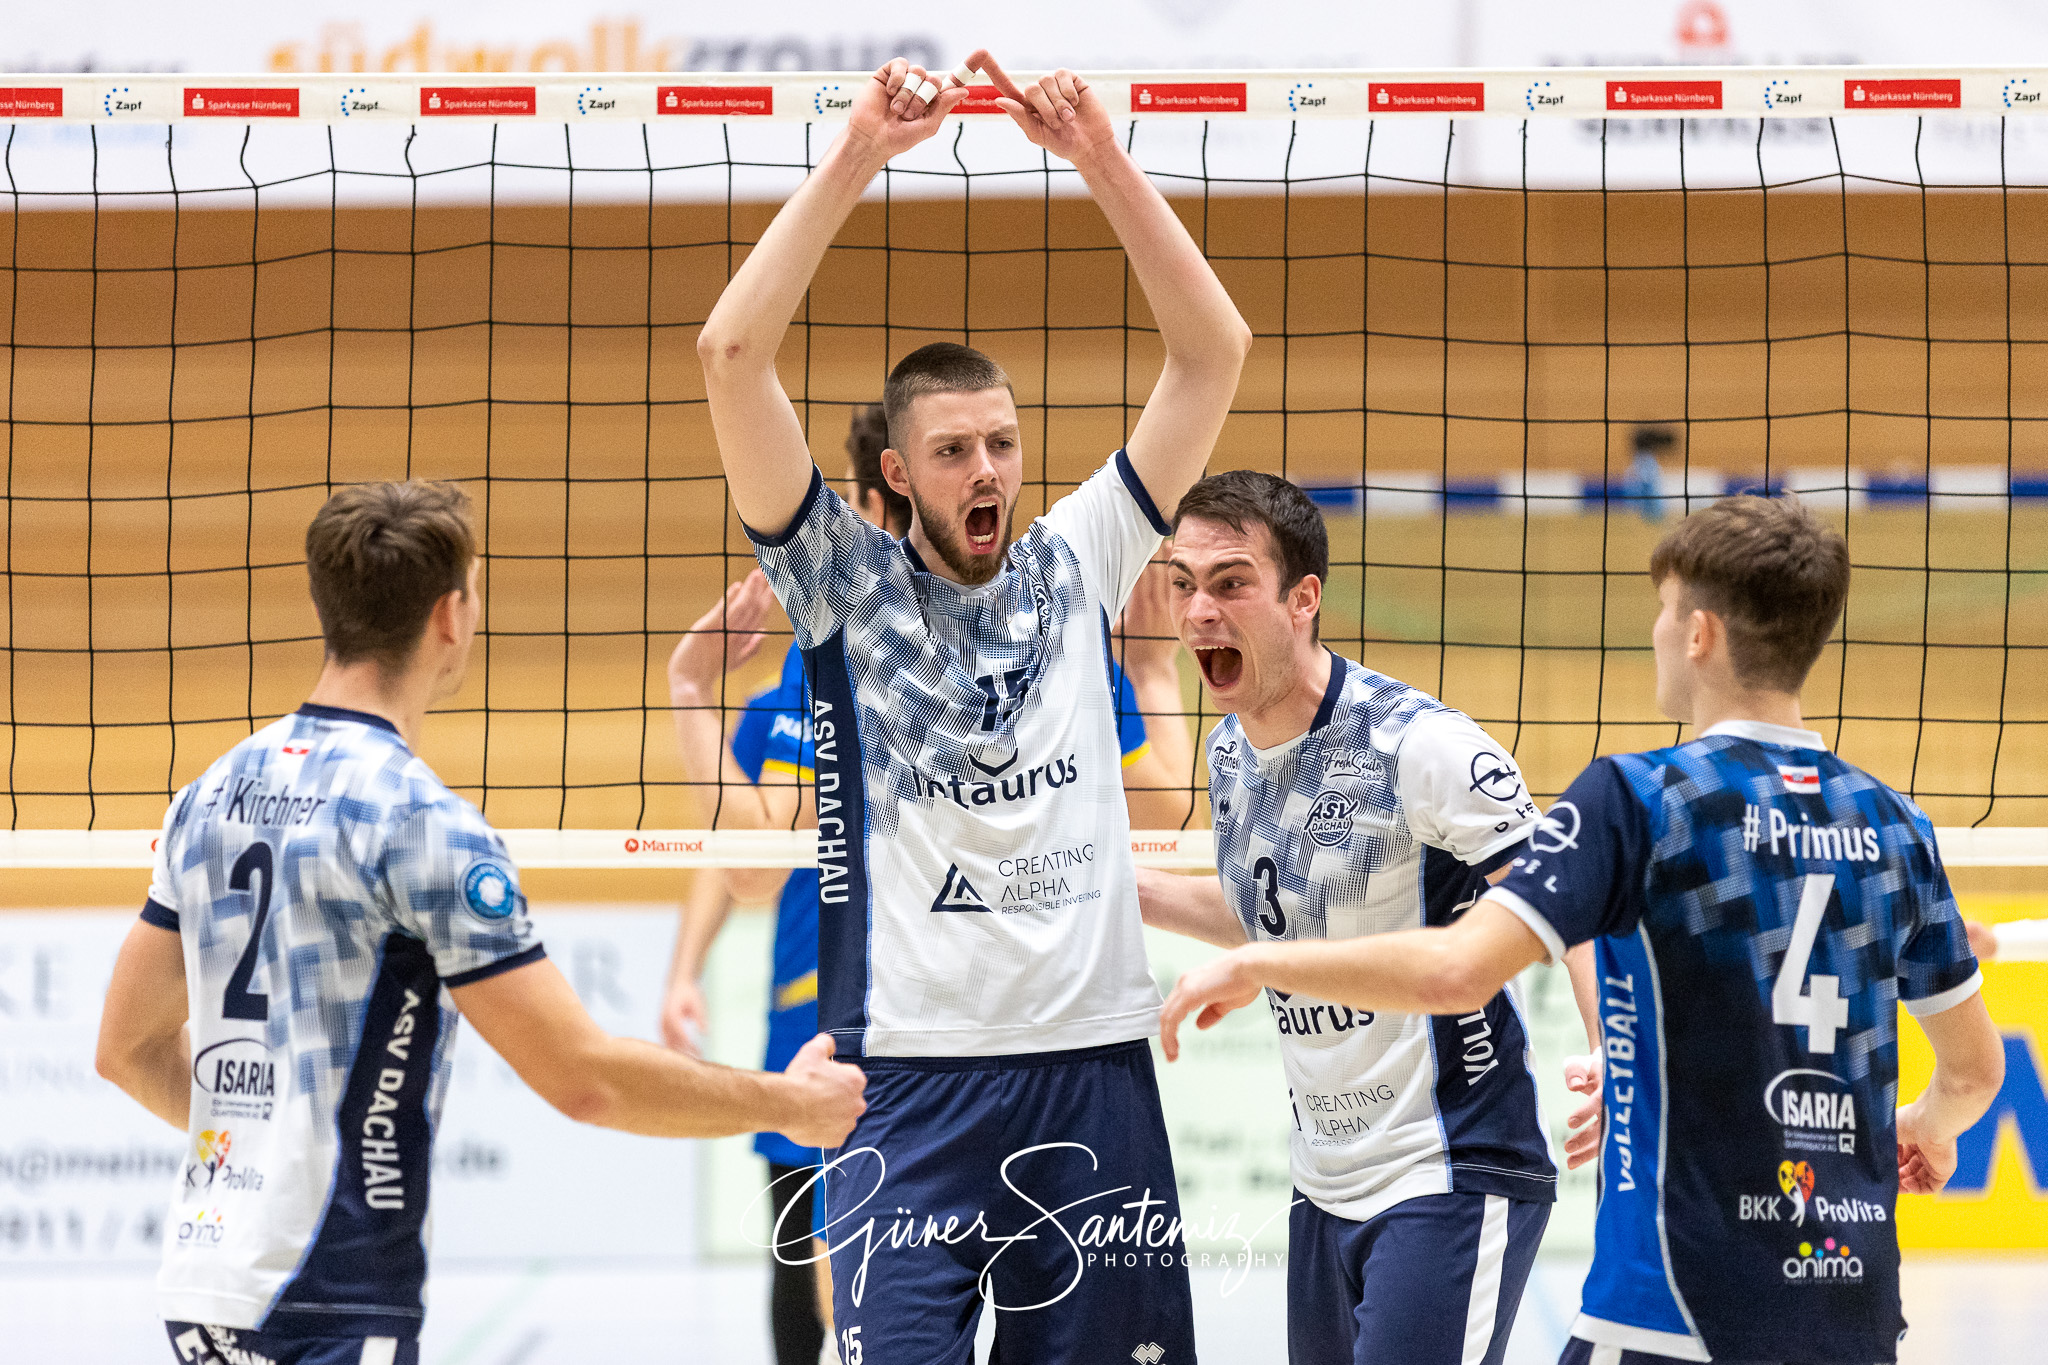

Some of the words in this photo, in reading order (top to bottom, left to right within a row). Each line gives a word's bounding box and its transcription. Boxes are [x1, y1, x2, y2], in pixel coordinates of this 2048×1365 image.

[15, 100, 55, 111] Nürnberg
[444, 100, 487, 111] Sparkasse
[488, 99, 528, 111] Nürnberg
[589, 99, 616, 110] Zapf
[681, 99, 724, 110] Sparkasse
[725, 98, 765, 110] Nürnberg
[826, 98, 852, 110] Zapf
[1155, 96, 1198, 107] Sparkasse
[1199, 95, 1239, 107] Nürnberg
[1299, 96, 1326, 107] Zapf
[1392, 96, 1435, 107] Sparkasse
[1436, 95, 1476, 107] Nürnberg
[1537, 95, 1564, 106] Zapf
[1630, 94, 1673, 105] Sparkasse
[1674, 93, 1714, 105] Nürnberg
[1775, 93, 1802, 104] Zapf
[1869, 92, 1912, 103] Sparkasse
[1913, 91, 1953, 103] Nürnberg
[2014, 92, 2041, 103] Zapf
[115, 101, 142, 112] Zapf
[207, 101, 250, 112] Sparkasse
[251, 100, 291, 112] Nürnberg
[352, 101, 379, 112] Zapf
[813, 699, 838, 762] ASV
[1304, 800, 1359, 831] ASV
[1311, 821, 1351, 832] DACHAU
[642, 839, 703, 852] Marmot
[816, 772, 850, 904] DACHAU
[1131, 840, 1177, 852] armot
[998, 844, 1095, 877] CREATING
[1001, 877, 1071, 903] ALPHA
[1252, 856, 1288, 937] 3
[1001, 900, 1061, 915] RESPONSIBLE
[1062, 889, 1101, 907] INVESTING
[221, 841, 274, 1021] 2
[1772, 873, 1850, 1054] 4
[386, 988, 421, 1061] ASV
[213, 1058, 275, 1097] ISARIA
[1605, 973, 1639, 1193] VOLLEYBALL
[1305, 1084, 1395, 1112] CREATING
[1781, 1088, 1856, 1130] ISARIA
[1315, 1116, 1370, 1137] ALPHA
[362, 1067, 405, 1209] DACHAU
[1739, 1194, 1782, 1221] BKK
[1815, 1195, 1887, 1223] ProVita
[1782, 1256, 1864, 1279] anima
[841, 1325, 863, 1365] 15
